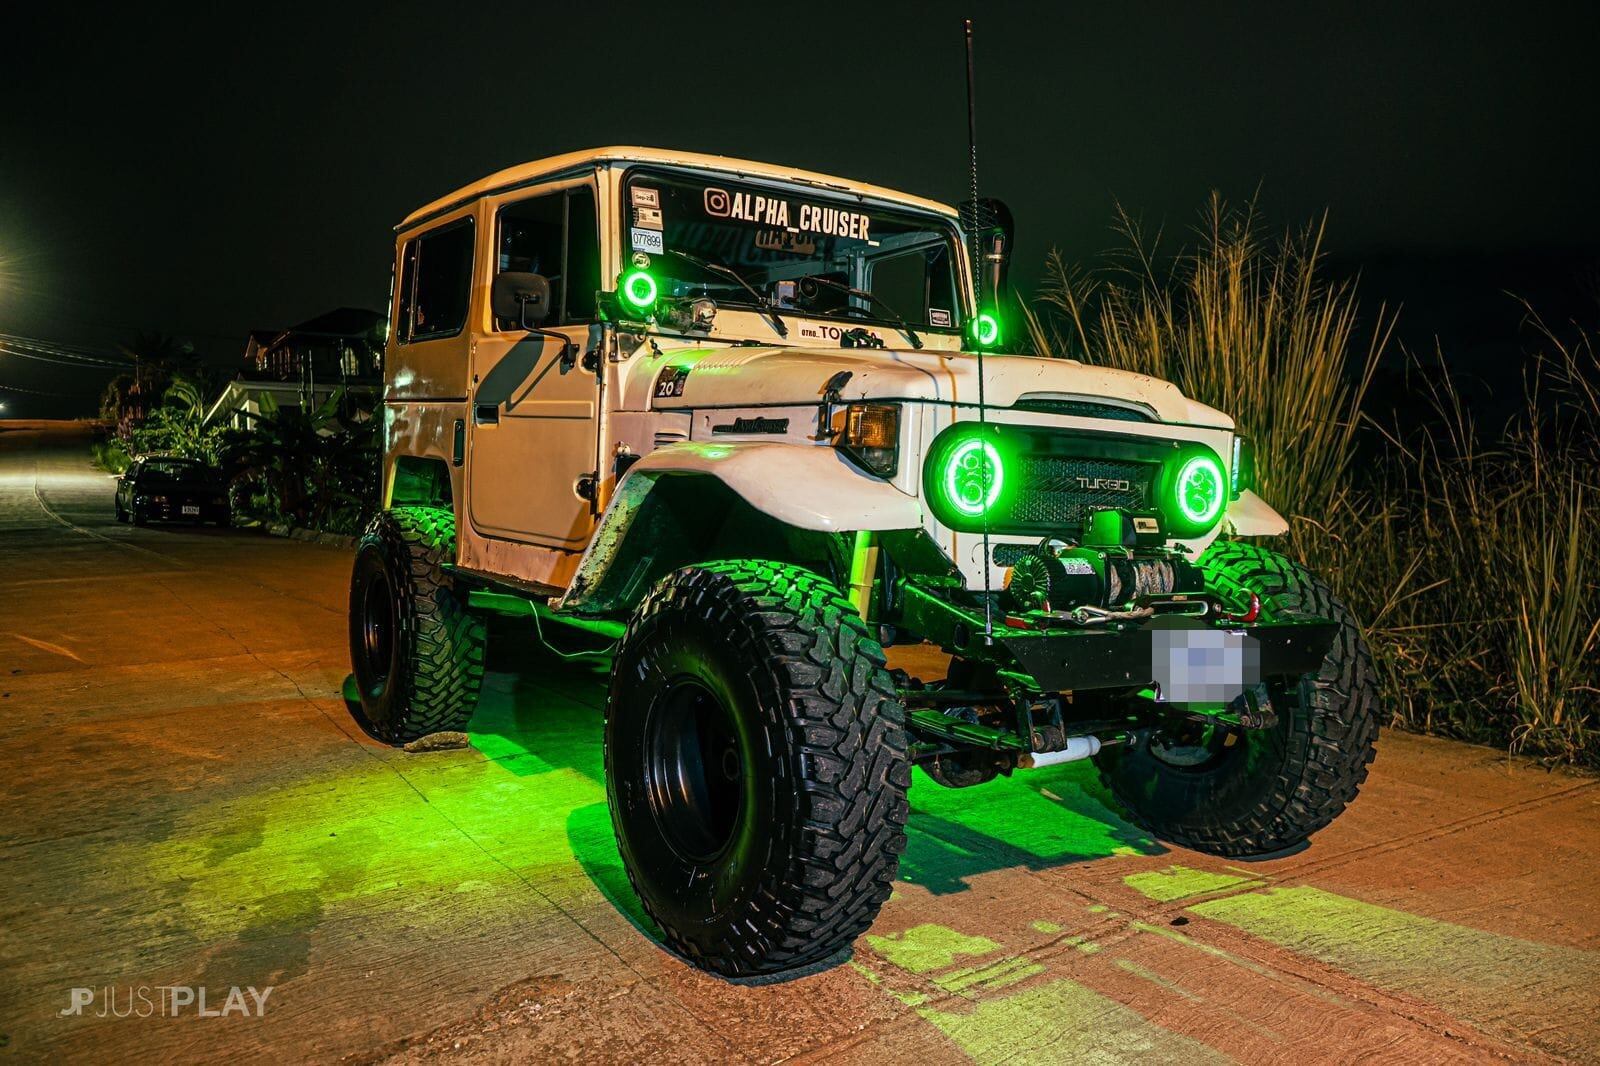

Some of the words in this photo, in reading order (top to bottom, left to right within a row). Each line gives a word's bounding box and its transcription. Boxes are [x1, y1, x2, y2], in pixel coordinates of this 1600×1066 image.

[730, 192, 880, 247] ALPHA_CRUISER_
[633, 233, 661, 248] 077899
[658, 381, 674, 396] 20
[1076, 477, 1130, 491] TURBO
